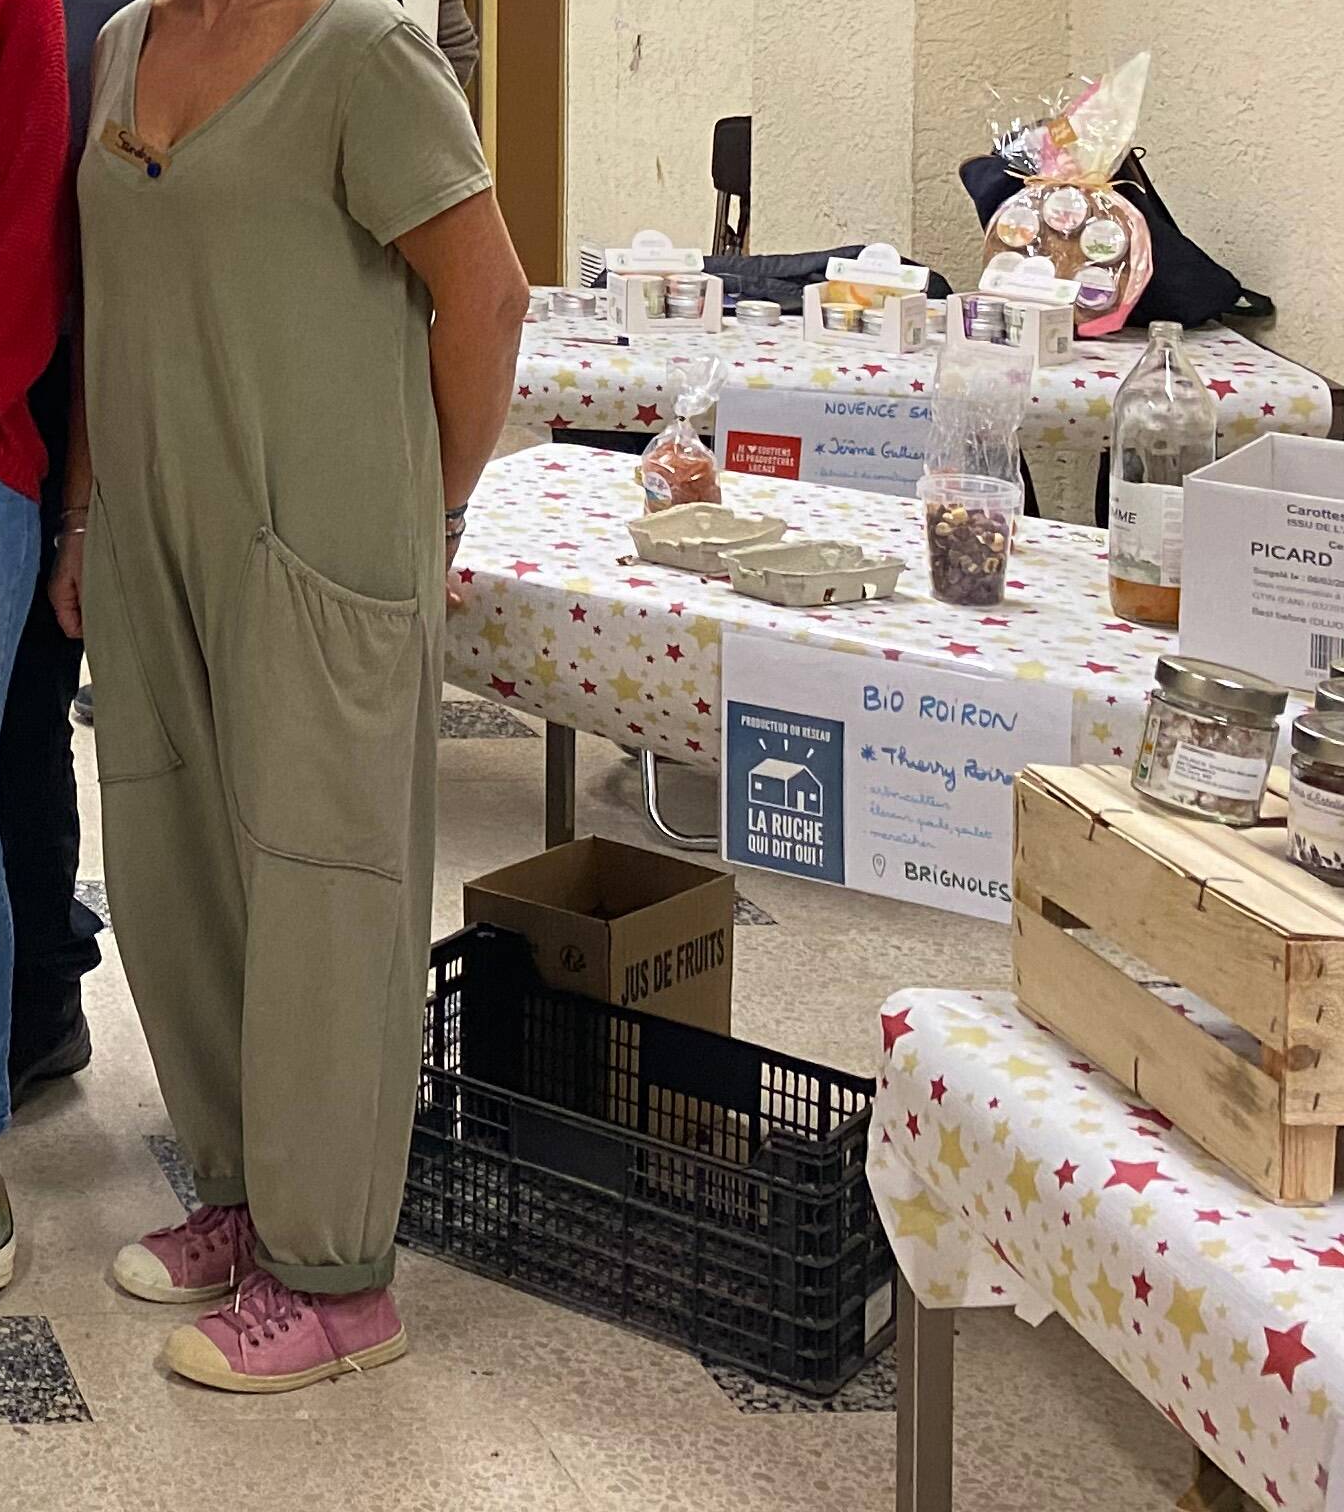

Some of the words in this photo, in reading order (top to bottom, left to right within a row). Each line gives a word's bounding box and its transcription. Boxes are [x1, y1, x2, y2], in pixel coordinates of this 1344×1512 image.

[825, 401, 898, 418] NOVENCE
[1287, 519, 1313, 530] ISSU
[1315, 522, 1331, 532] DE
[1251, 541, 1333, 567] PICARD
[741, 715, 788, 735] PRODUCTEUR
[789, 724, 800, 737] DU
[963, 758, 1013, 787] Roiro
[748, 808, 767, 833] LA
[772, 813, 823, 845] RUCHE
[748, 834, 768, 854] QUI
[772, 838, 792, 860] DIT
[620, 959, 649, 1006] JUS
[653, 950, 673, 993] DE
[676, 928, 725, 984] FRUITS
